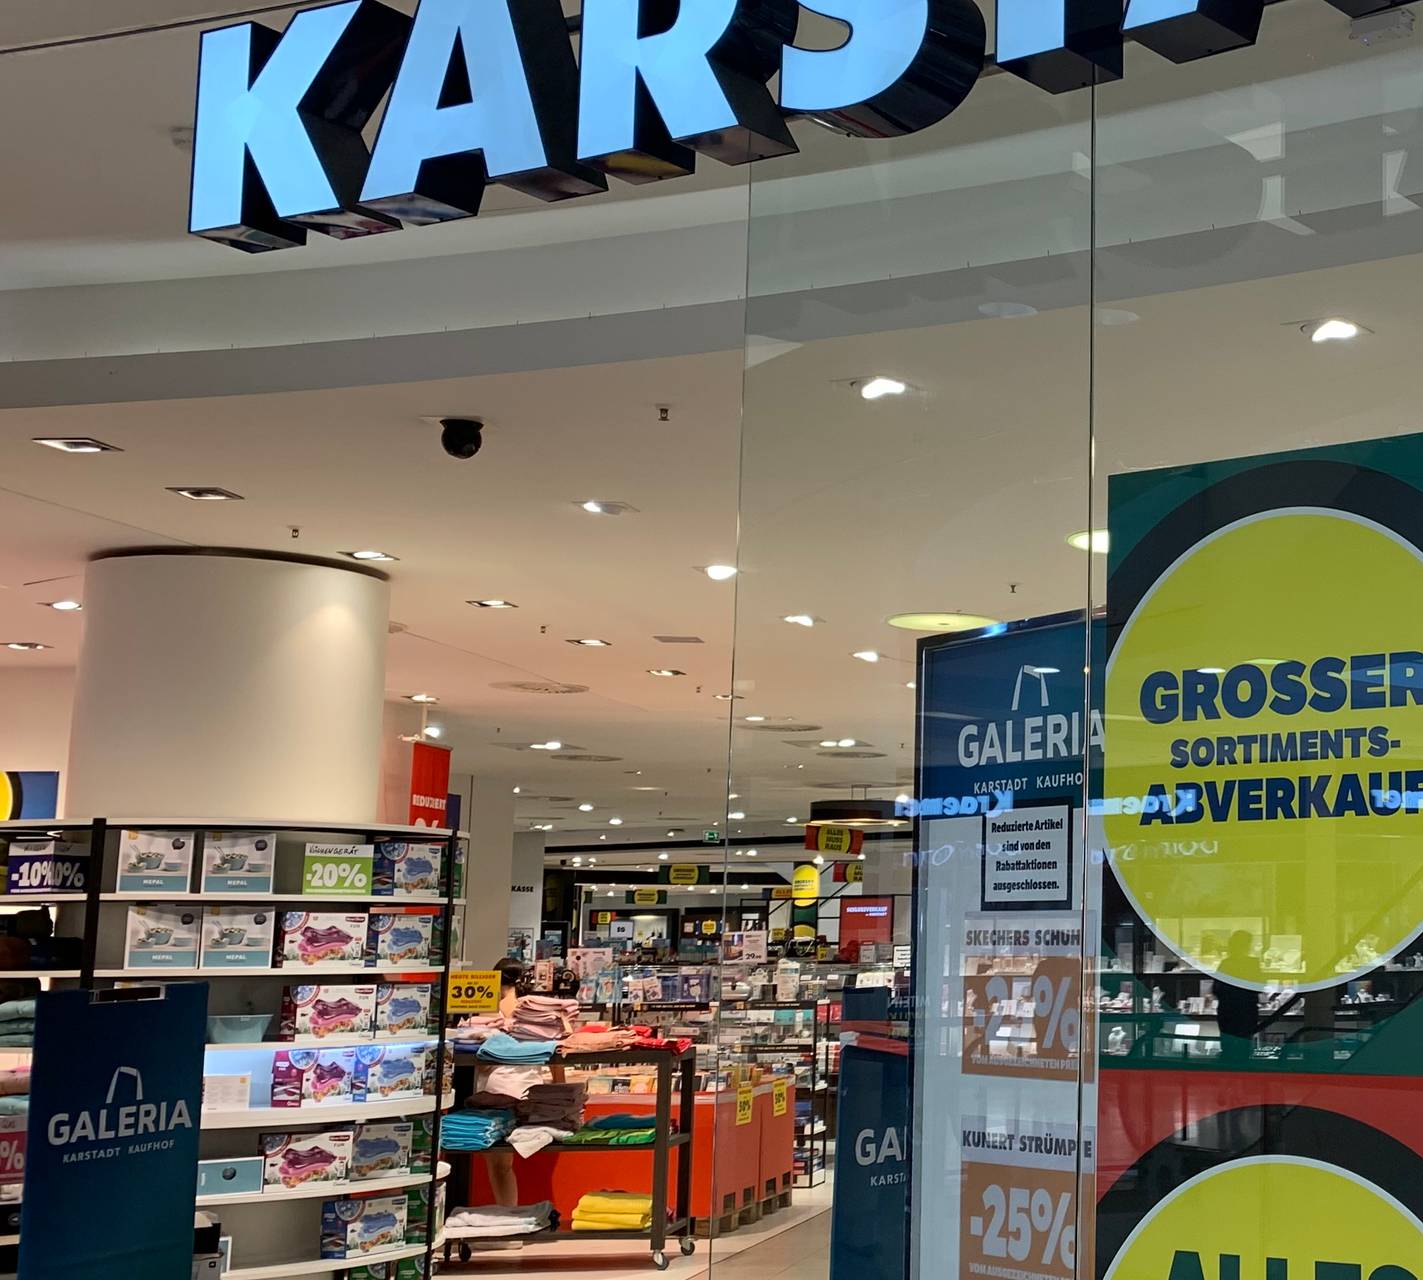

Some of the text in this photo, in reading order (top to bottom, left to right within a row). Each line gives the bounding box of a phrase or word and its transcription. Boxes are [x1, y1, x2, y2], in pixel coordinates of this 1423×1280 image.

[958, 708, 1105, 769] GALERIA
[1169, 725, 1401, 769] SORTIMENTS-
[973, 772, 1084, 795] KARSTADT KAUFHO
[991, 818, 1063, 833] Reduzierte Artikel
[1002, 840, 1051, 852] sind von den
[306, 863, 368, 888] -20%
[995, 858, 1058, 872] Rabattaktionen
[511, 885, 534, 893] KASSE
[992, 879, 1060, 893] ausgeschlossen.
[966, 929, 1030, 946] SKECHERS
[451, 985, 494, 999] 30%
[47, 1099, 193, 1147] GALERIA
[62, 1139, 175, 1164] KARSTADT KAUFHOF
[963, 1130, 1092, 1158] KUNERT STRÜMPE
[970, 1184, 1076, 1270] -25%
